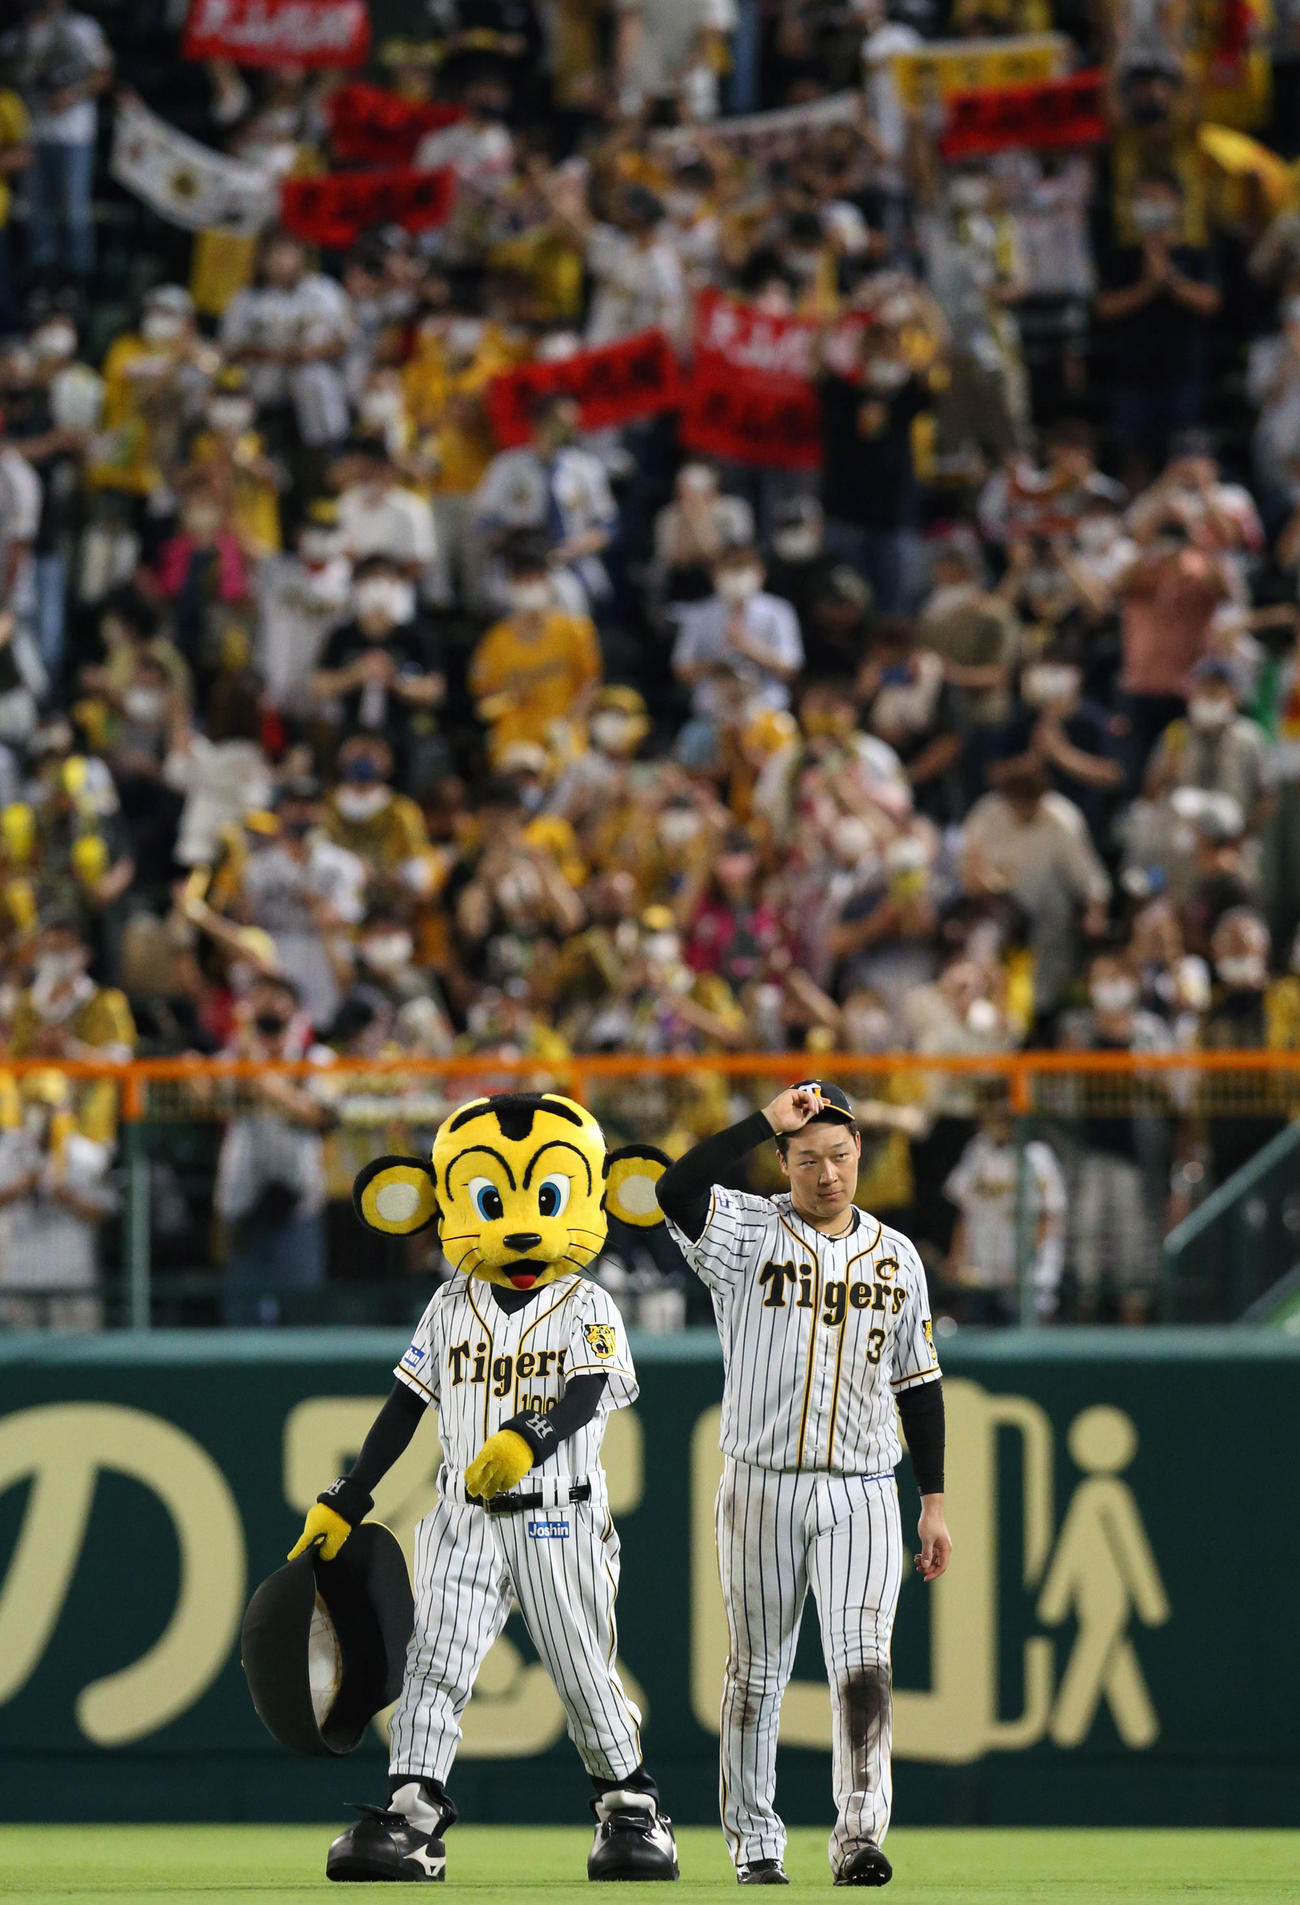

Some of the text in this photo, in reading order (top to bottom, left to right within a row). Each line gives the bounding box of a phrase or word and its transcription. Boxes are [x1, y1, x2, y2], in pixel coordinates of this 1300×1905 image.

[758, 1260, 906, 1326] Tigers
[866, 1328, 886, 1365] 3
[529, 1523, 569, 1537] Joshin
